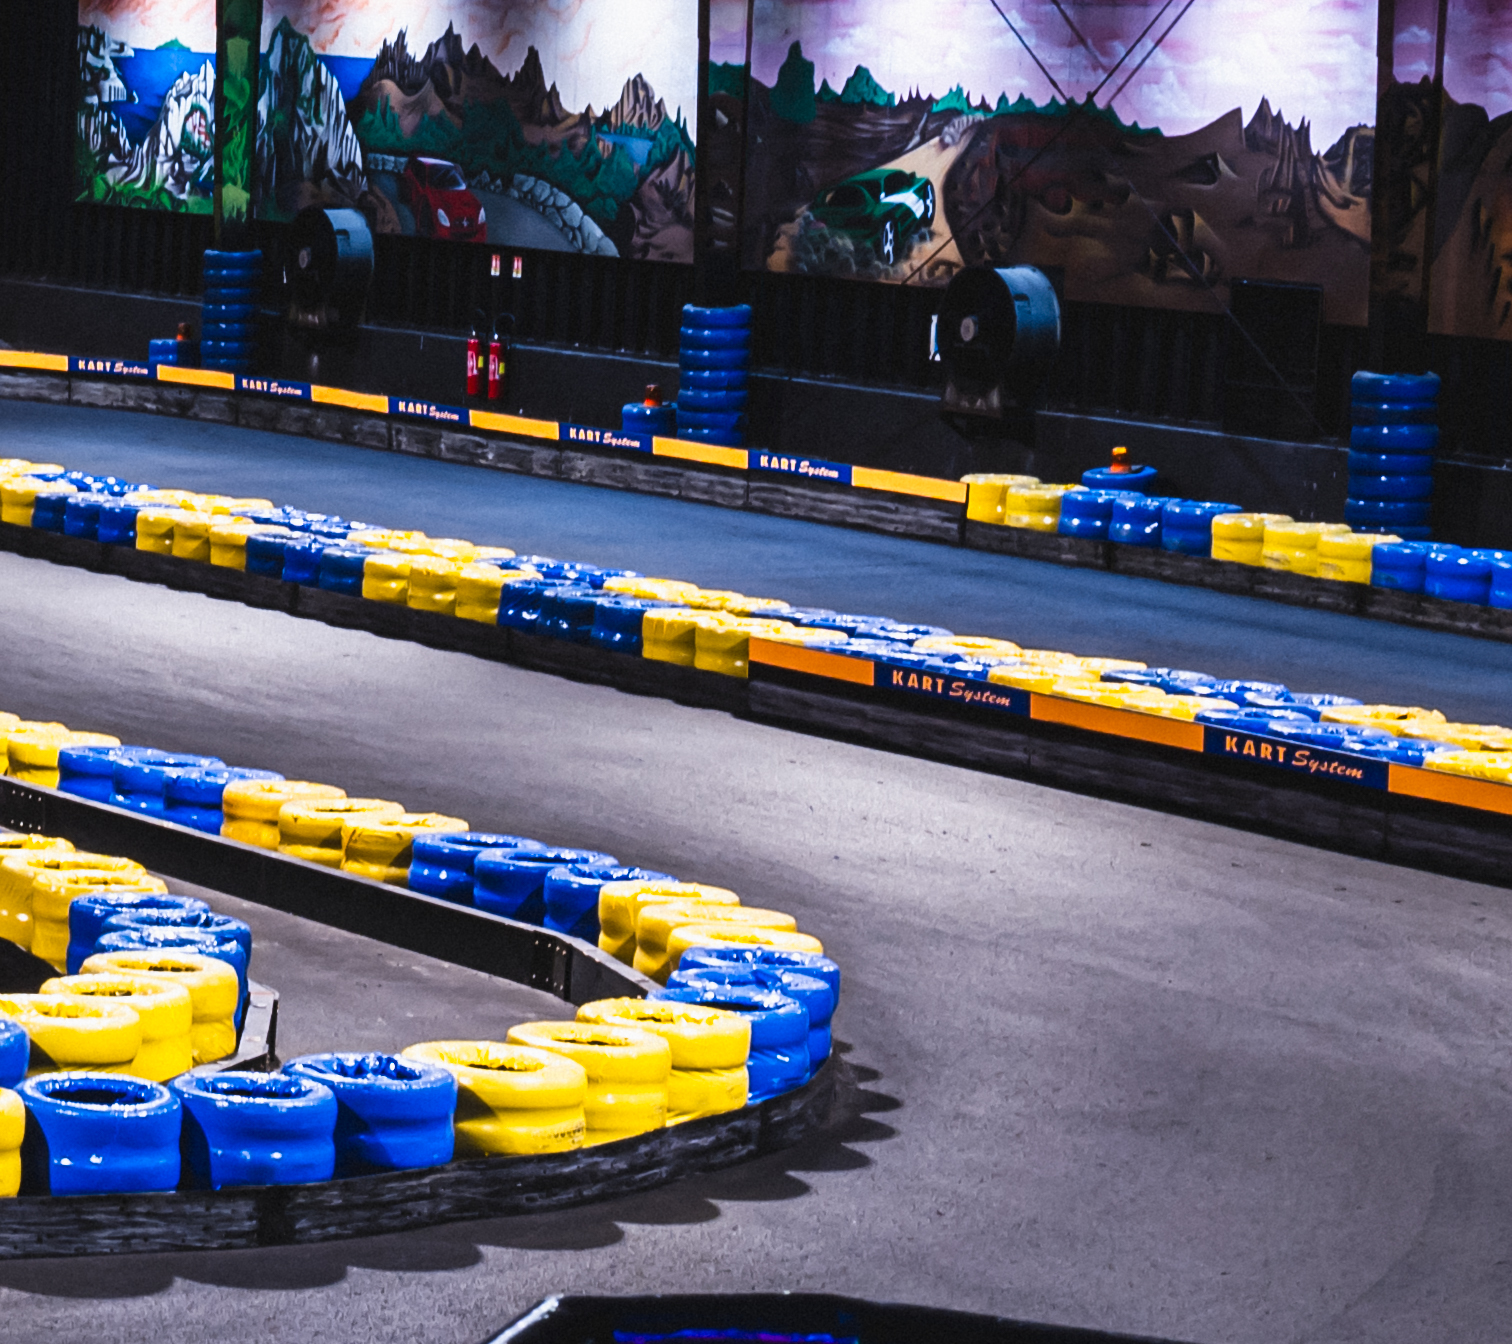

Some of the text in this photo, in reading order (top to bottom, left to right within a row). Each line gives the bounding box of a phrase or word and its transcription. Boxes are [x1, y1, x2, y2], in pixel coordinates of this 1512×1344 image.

[77, 359, 149, 375] KART System
[241, 378, 268, 392] KART
[398, 400, 427, 415] KART
[569, 427, 641, 448] KART System
[759, 454, 839, 479] KART System
[891, 669, 1012, 707] KART System
[1224, 734, 1364, 780] KART System
